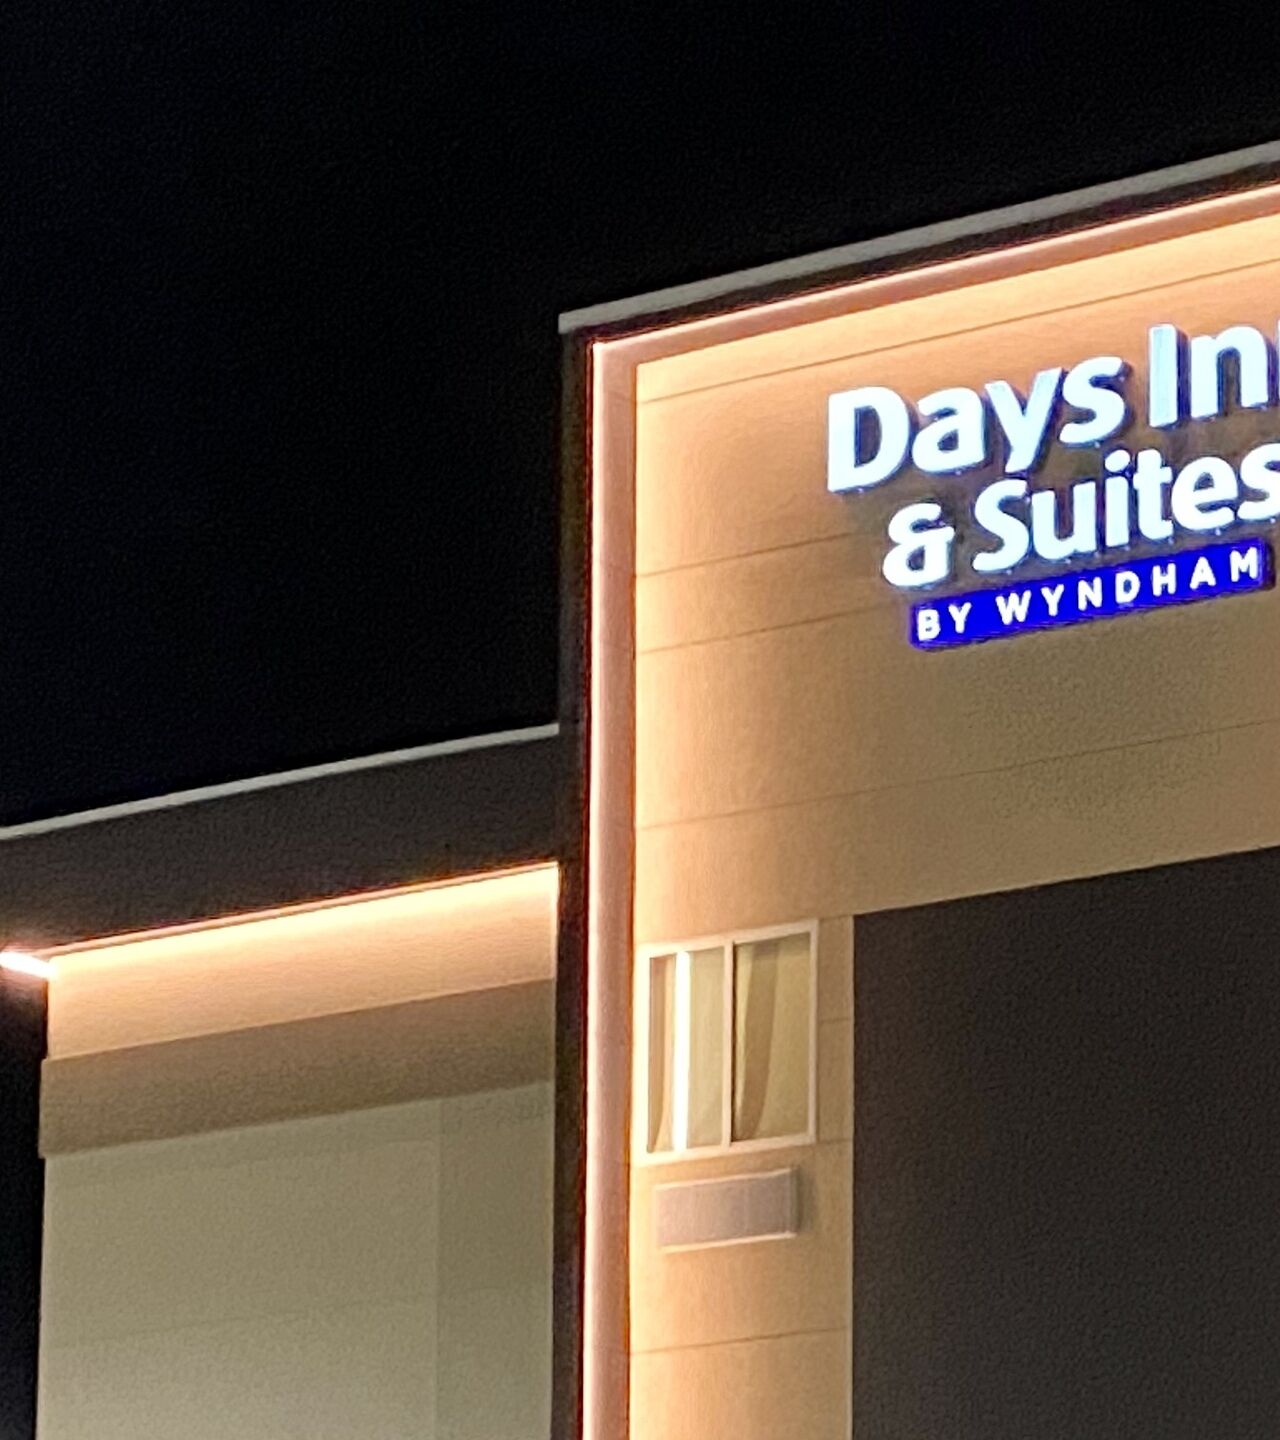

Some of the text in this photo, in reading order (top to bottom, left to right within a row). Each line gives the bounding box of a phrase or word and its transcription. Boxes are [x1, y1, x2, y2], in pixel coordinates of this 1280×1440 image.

[827, 355, 1128, 492] Days
[882, 502, 956, 588] &
[917, 547, 1259, 641] BY WYNDHAM
